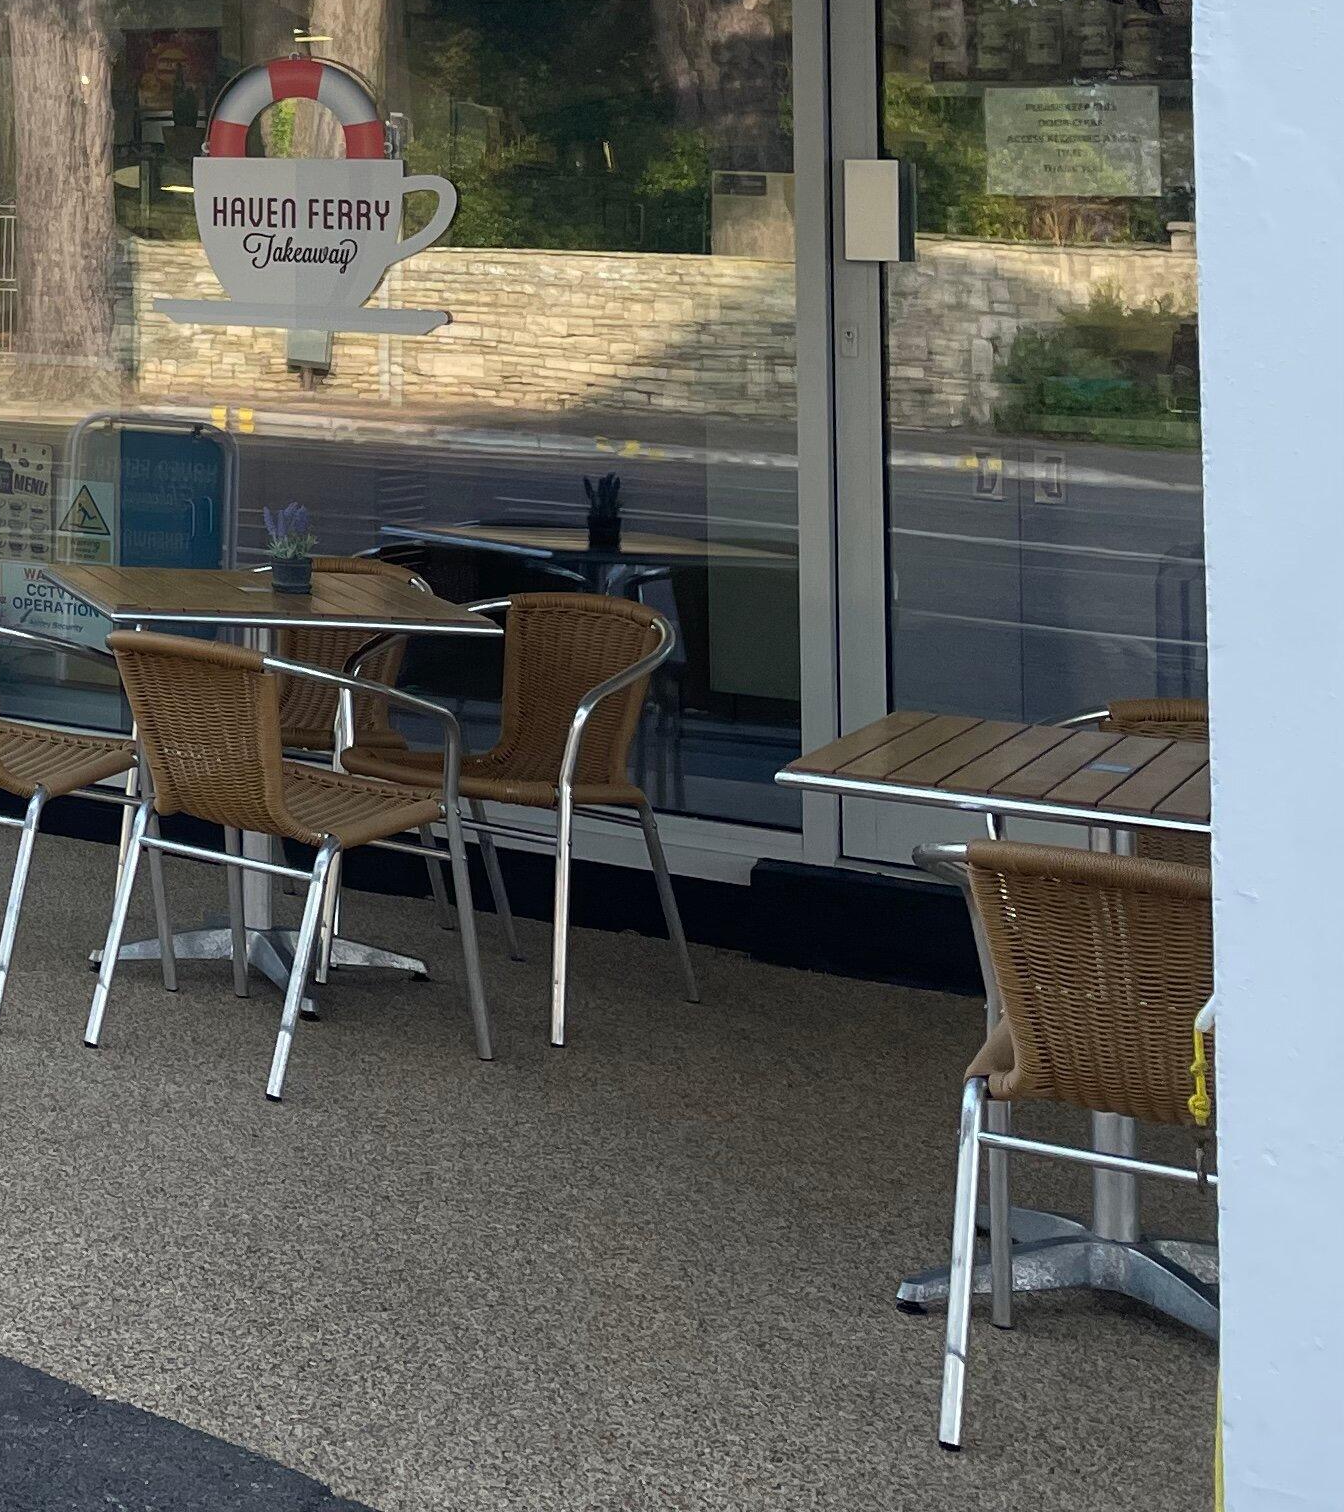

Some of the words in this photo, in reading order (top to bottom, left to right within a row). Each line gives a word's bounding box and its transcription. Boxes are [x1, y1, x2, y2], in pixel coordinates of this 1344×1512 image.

[212, 196, 297, 229] HAVEN
[308, 198, 391, 232] FERRY
[242, 231, 358, 274] Takeaway
[14, 473, 49, 497] MENU
[26, 583, 66, 600] CCTV
[12, 596, 100, 618] OPERATION
